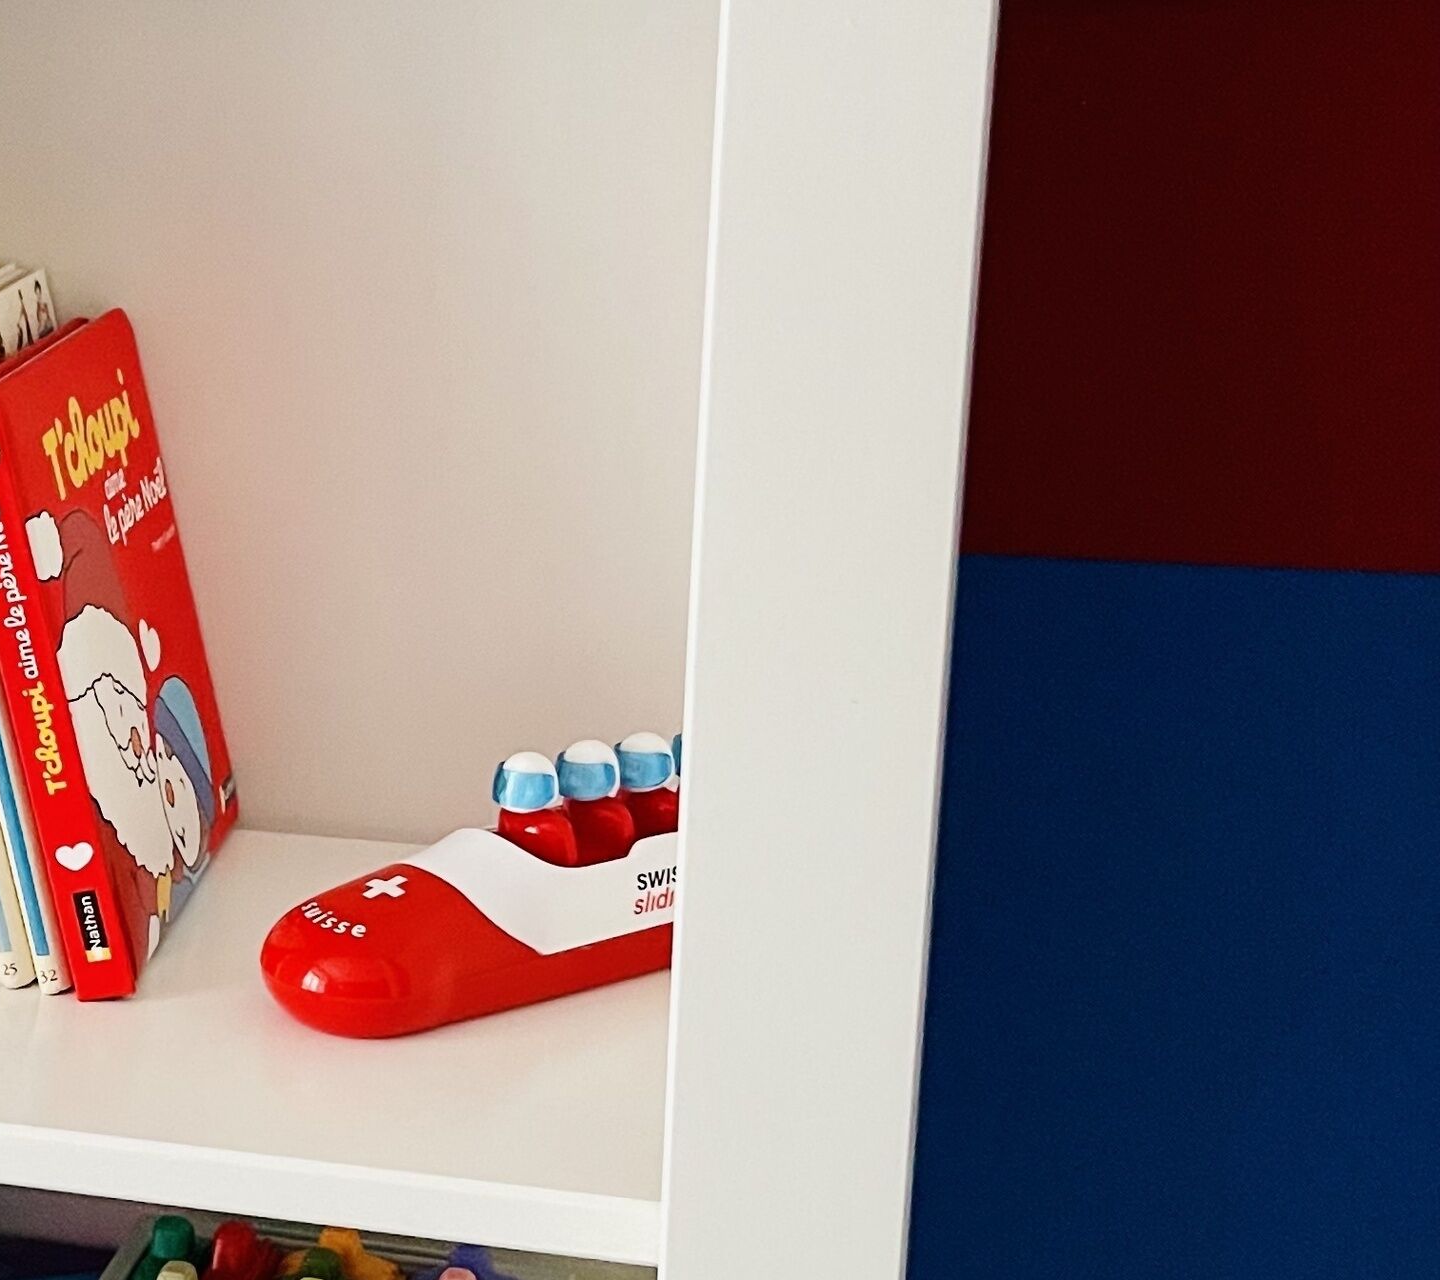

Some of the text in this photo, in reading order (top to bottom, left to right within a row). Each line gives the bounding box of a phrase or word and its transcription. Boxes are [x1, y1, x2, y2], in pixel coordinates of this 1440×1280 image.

[42, 368, 140, 501] T'choupi
[3, 604, 27, 629] le
[15, 628, 40, 680] aime
[21, 681, 68, 796] T'choupi
[79, 894, 101, 951] Nathan
[301, 900, 367, 939] suisse
[1, 963, 18, 976] 25
